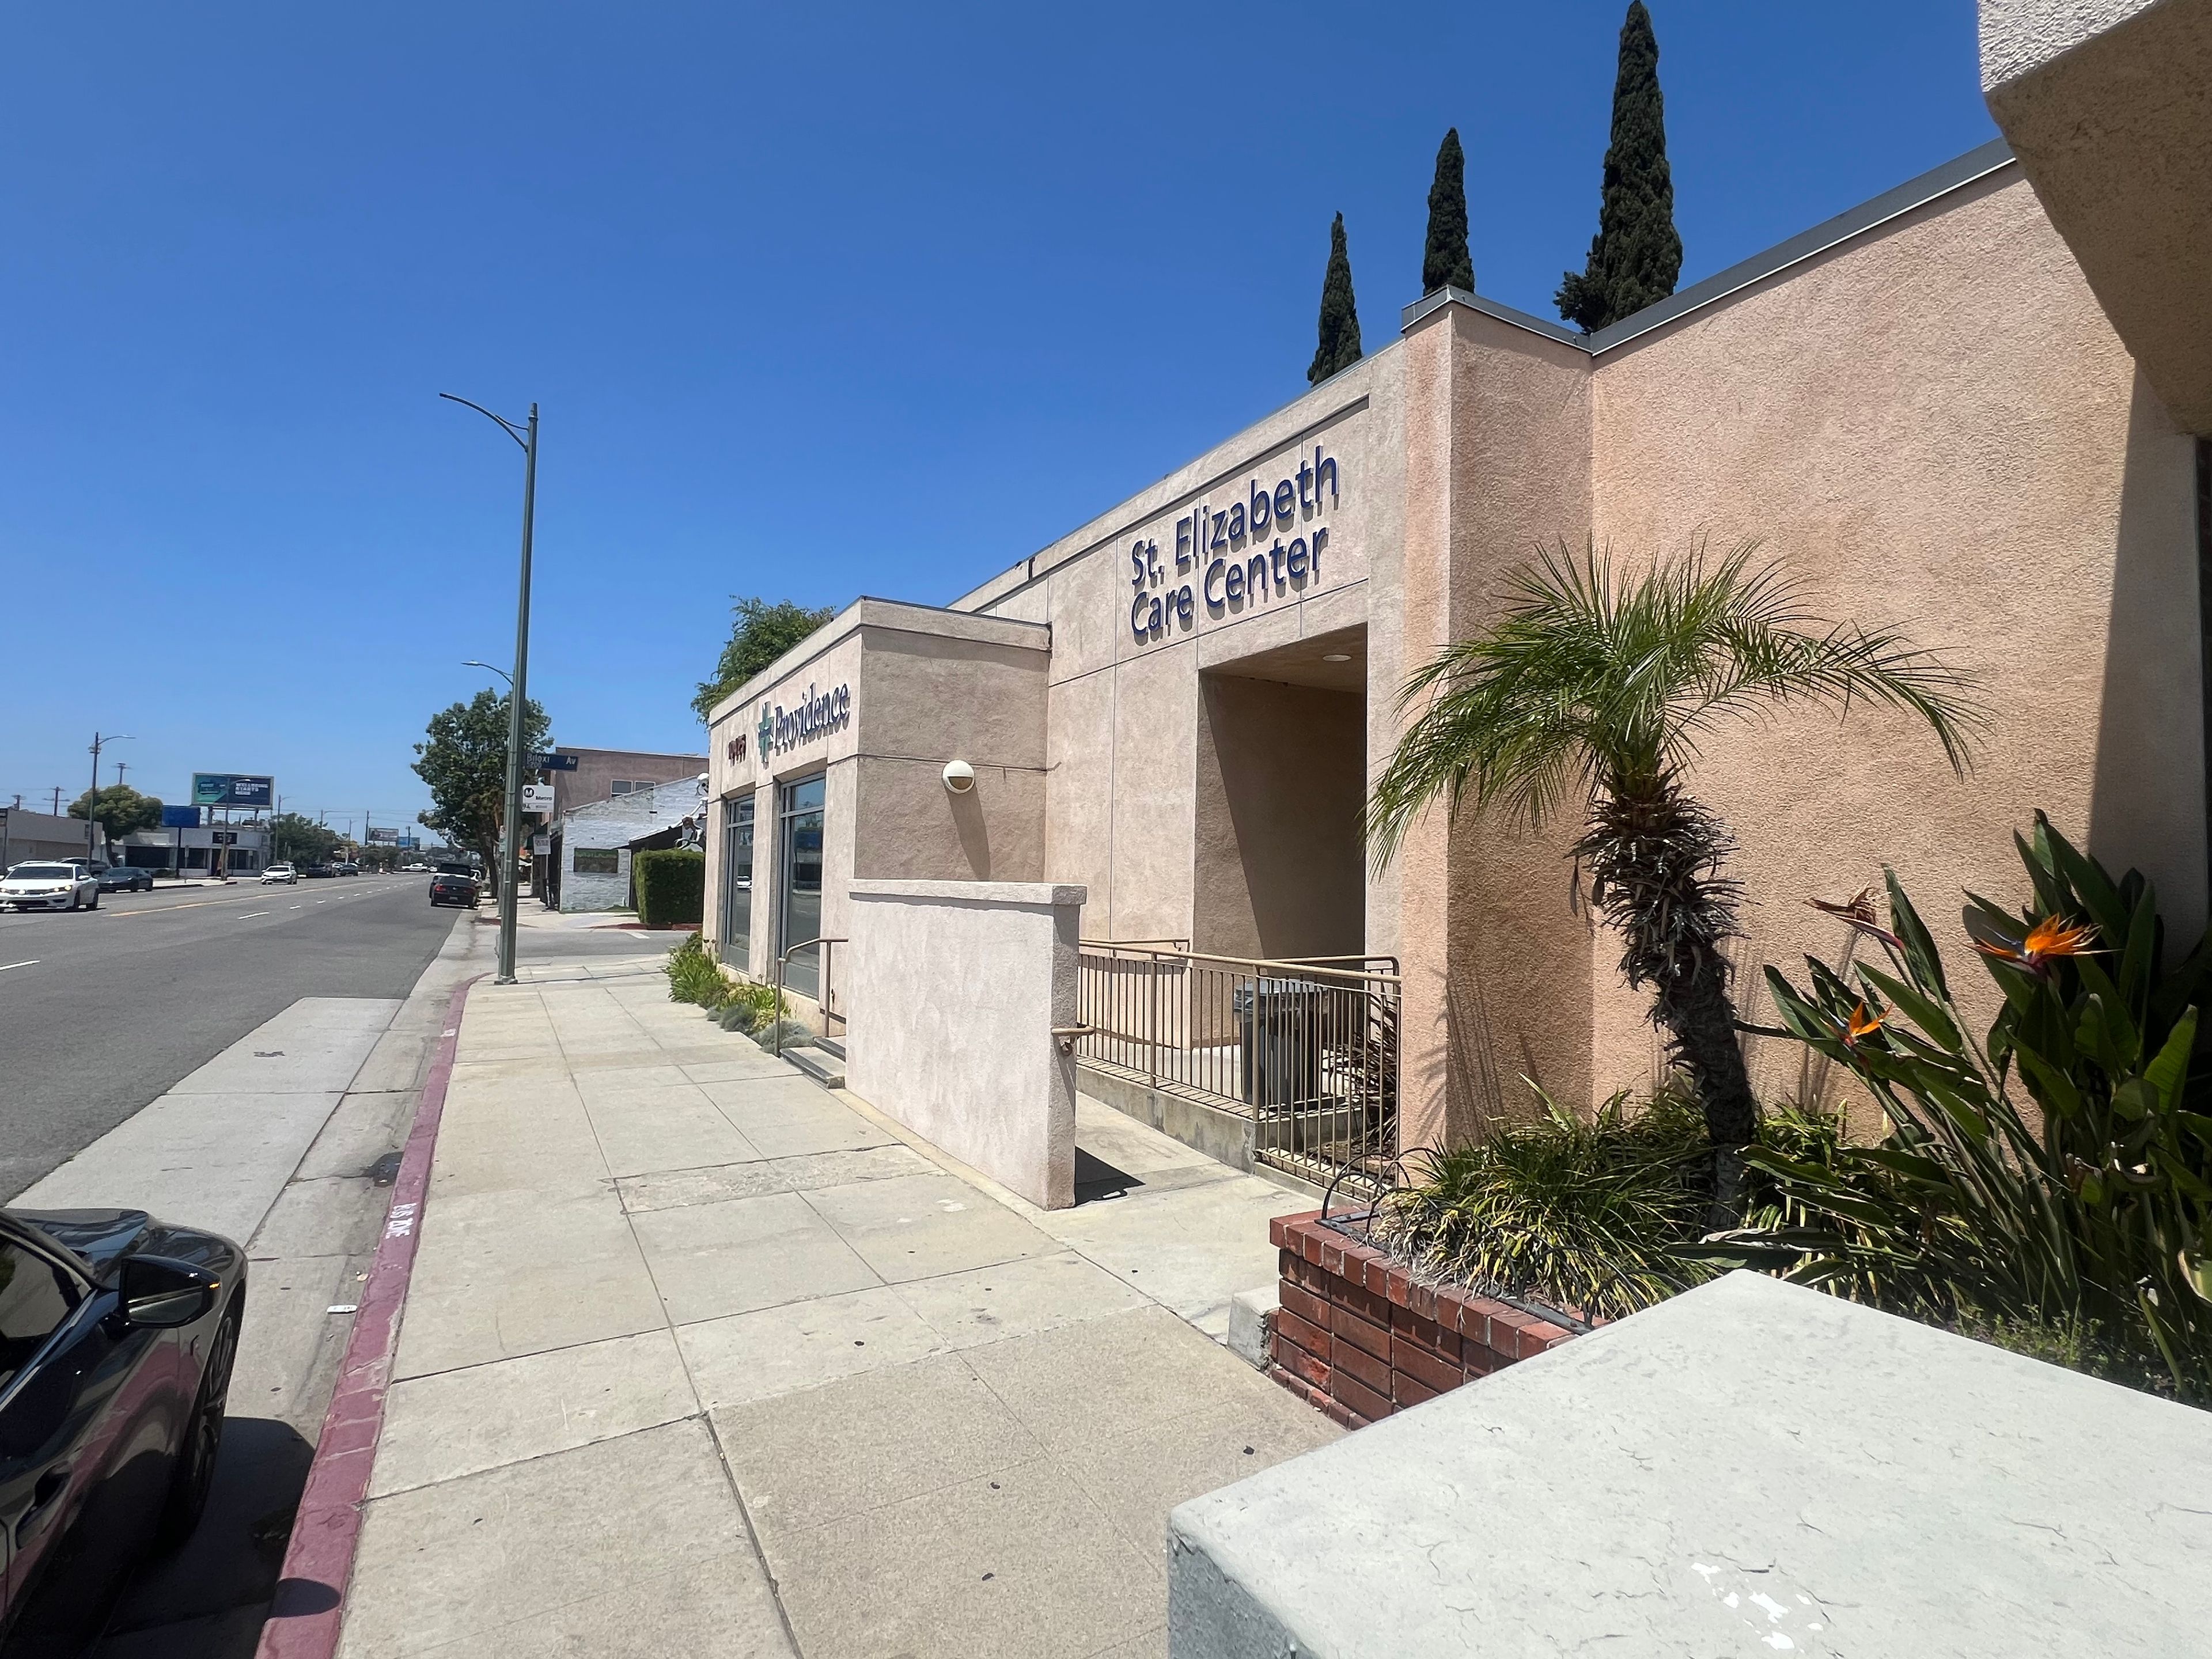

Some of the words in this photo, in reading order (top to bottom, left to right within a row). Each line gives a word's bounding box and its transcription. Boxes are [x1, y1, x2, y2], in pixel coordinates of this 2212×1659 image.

[1131, 538, 1165, 586] St.
[1176, 445, 1340, 566] Elizabeth
[1131, 584, 1194, 635] Care
[1205, 527, 1330, 609] Center
[774, 682, 849, 749] Providence
[527, 753, 550, 764] Biloxi
[566, 756, 576, 765] Av
[525, 789, 533, 797] M
